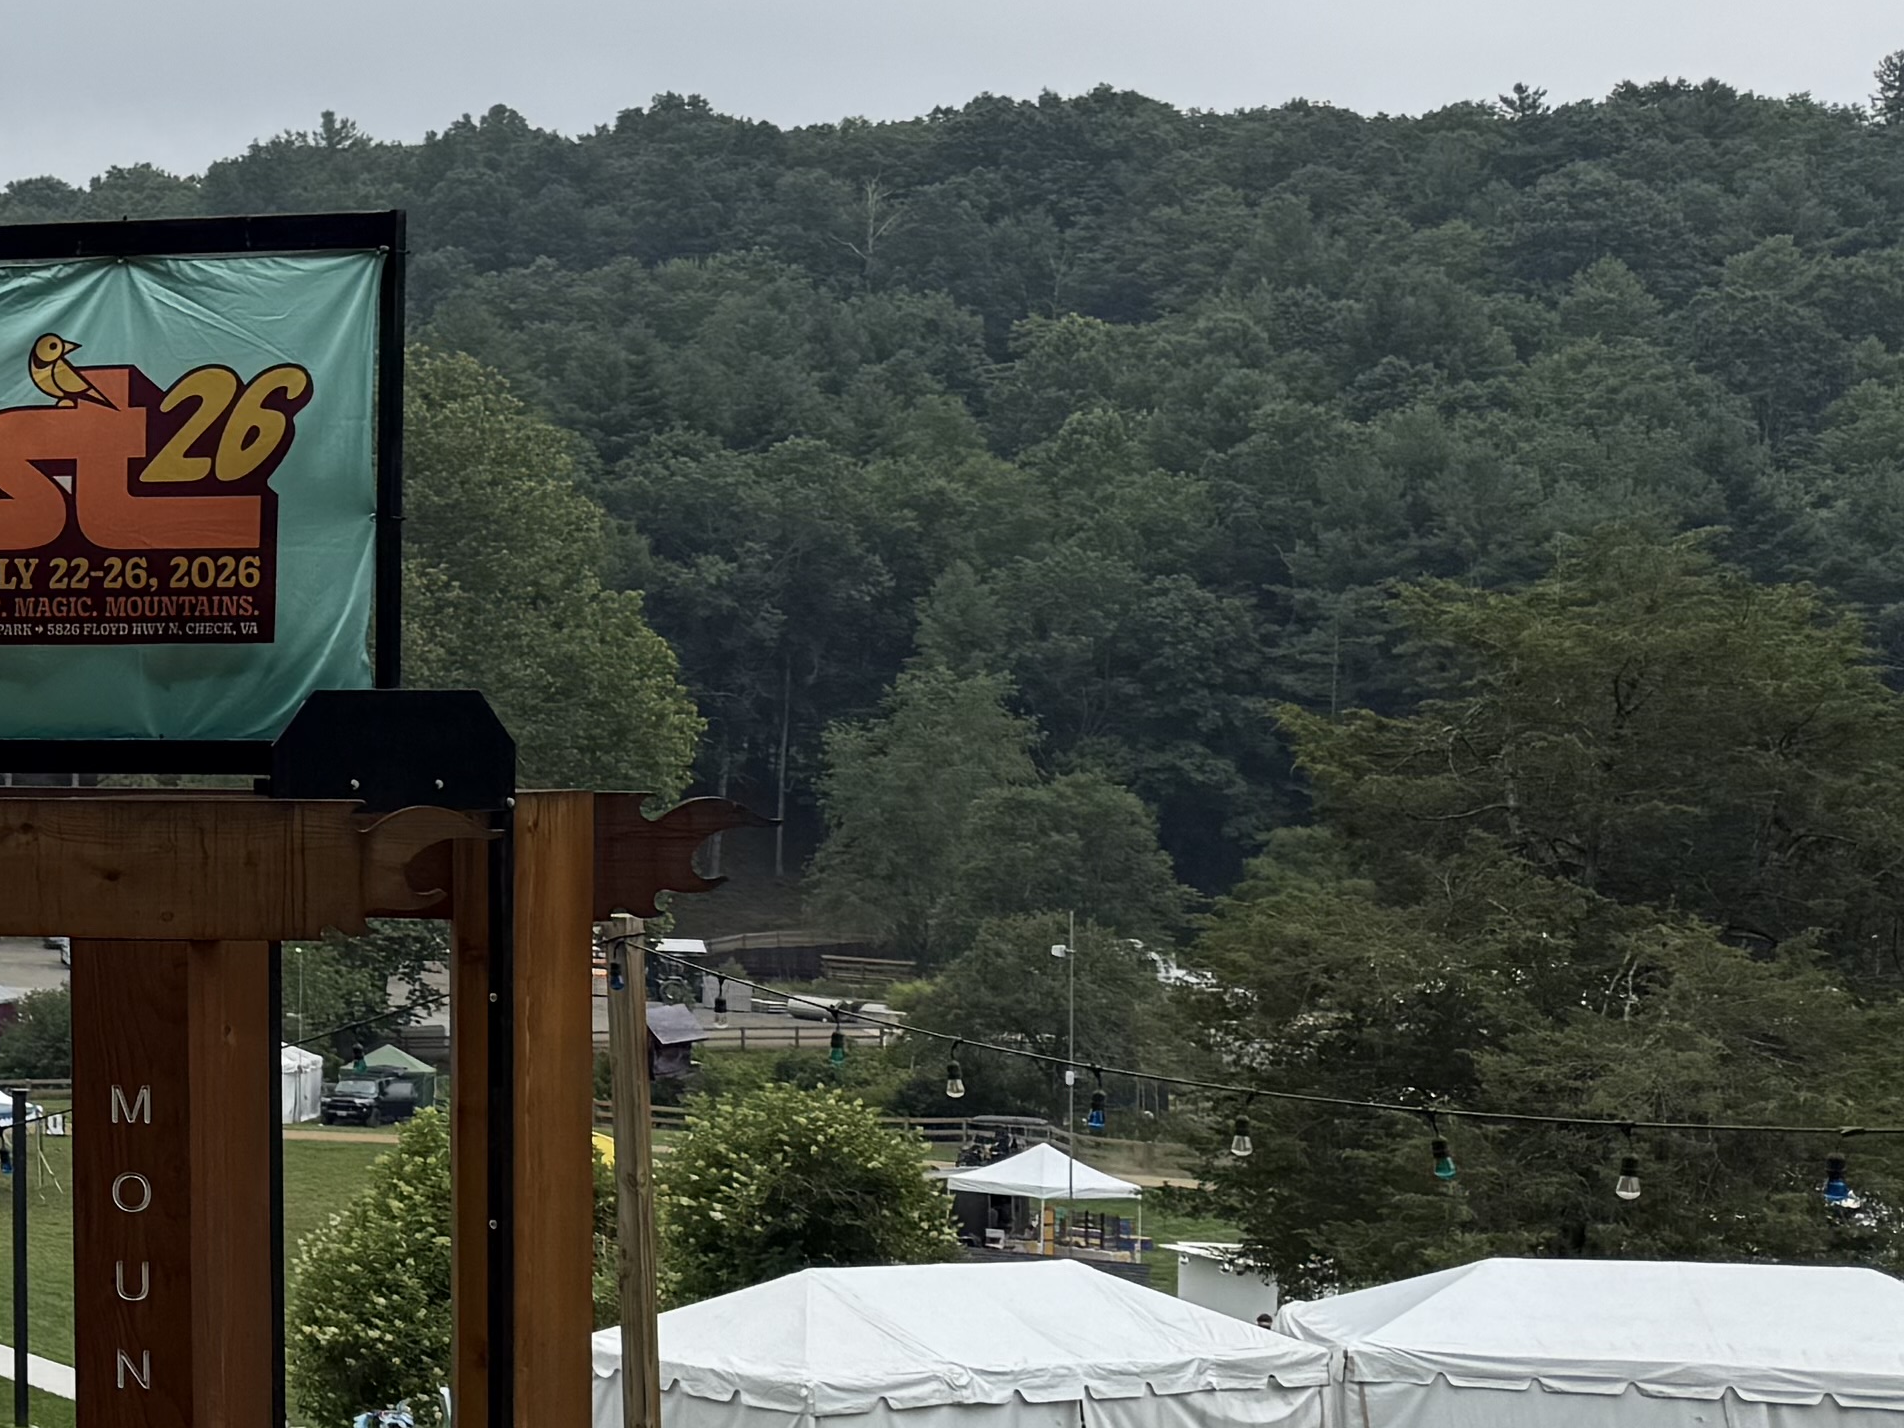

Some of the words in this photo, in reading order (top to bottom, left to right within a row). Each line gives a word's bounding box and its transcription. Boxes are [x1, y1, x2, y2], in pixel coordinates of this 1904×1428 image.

[139, 368, 308, 483] 26
[49, 556, 159, 592] 22-26,
[169, 556, 261, 589] 2026
[14, 596, 97, 617] MAGIC.
[104, 595, 260, 617] MOUNTAINS.
[47, 623, 80, 636] 5826
[83, 623, 129, 636] FLOYD
[131, 623, 165, 636] HWY
[185, 622, 237, 636] CHECK,
[241, 621, 259, 635] VA
